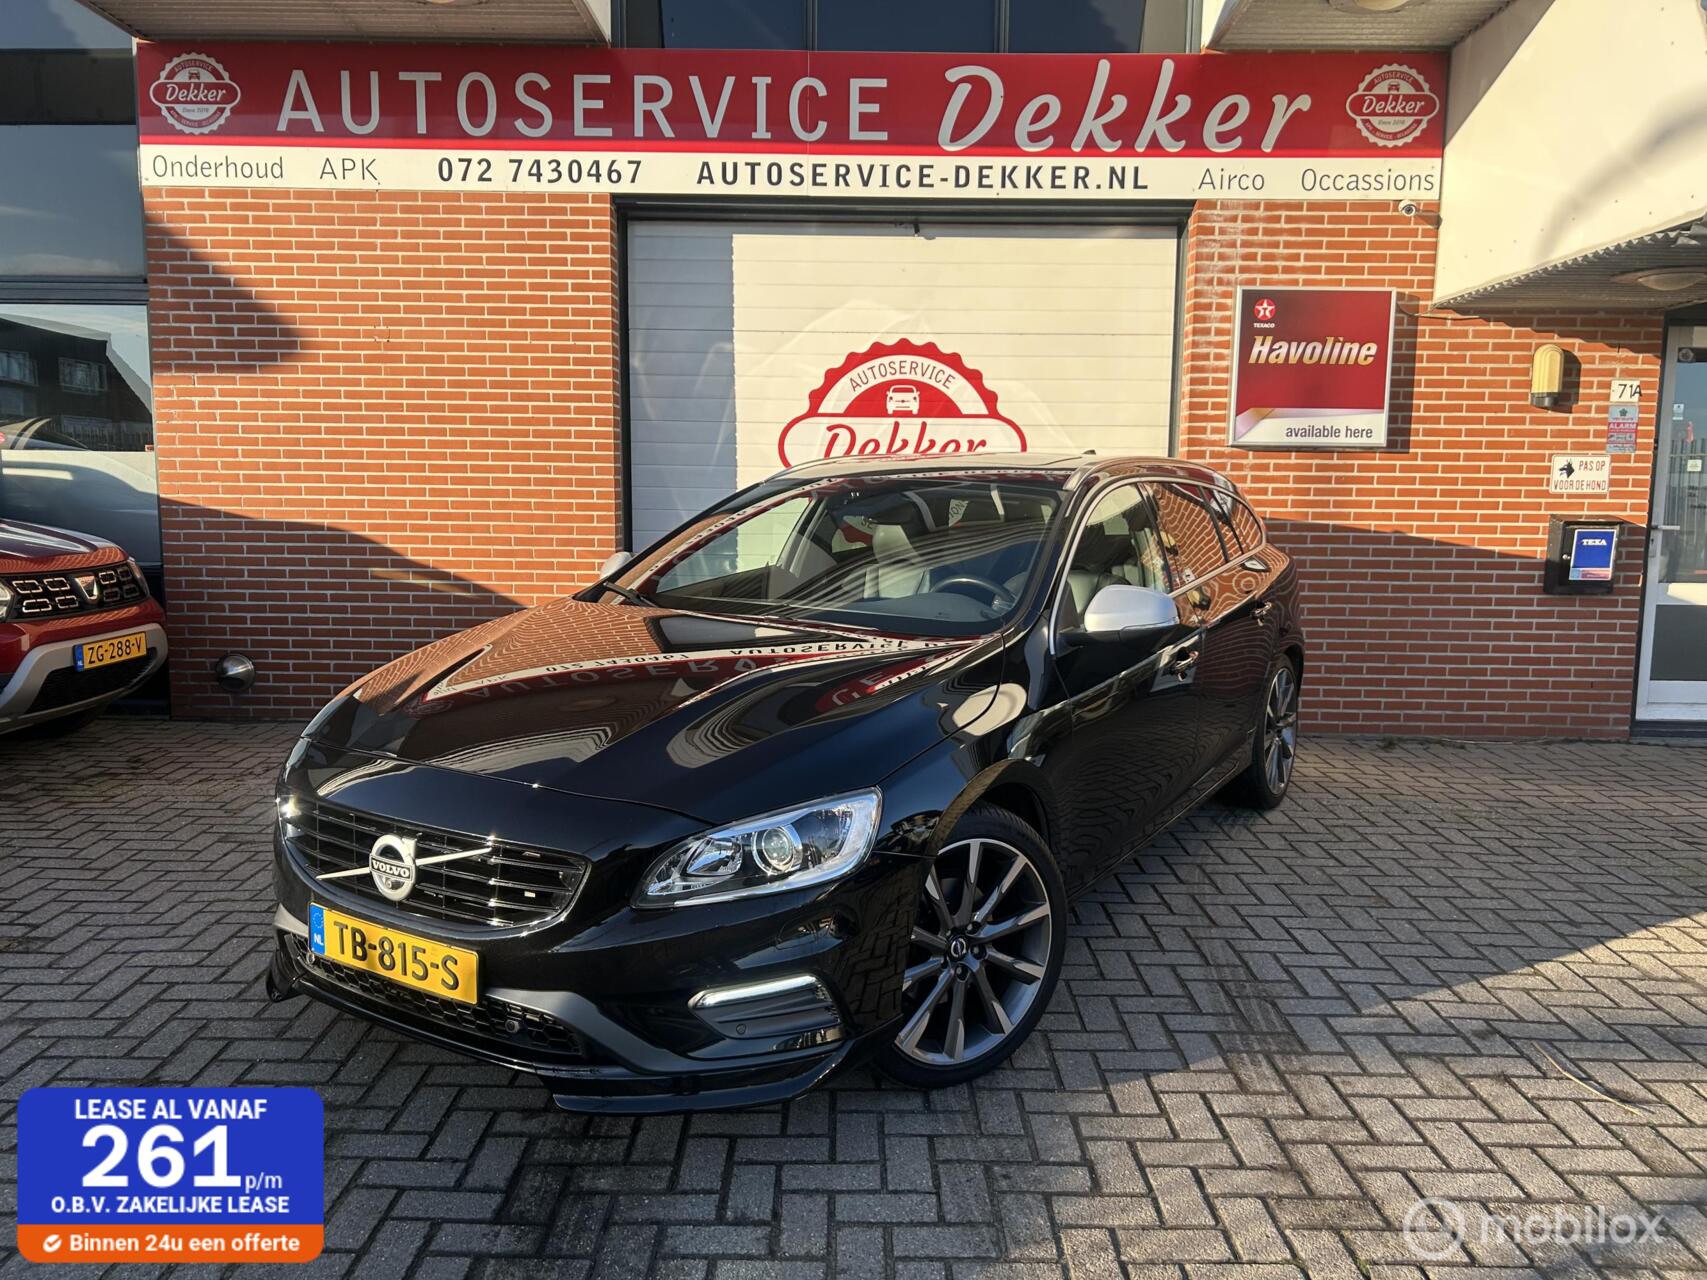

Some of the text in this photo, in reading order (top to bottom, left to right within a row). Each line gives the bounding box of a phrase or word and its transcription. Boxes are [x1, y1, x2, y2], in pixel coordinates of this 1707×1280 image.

[166, 83, 226, 101] Dekker
[276, 58, 1311, 152] AUTOSERVICE Dekker
[1362, 95, 1424, 114] Dekker
[152, 154, 379, 181] Onderhoud APK
[437, 157, 643, 184] 072 7430467
[696, 161, 1149, 190] AUTOSERVICE-DEKKER.NL
[1198, 168, 1435, 191] Airco Occassions
[1248, 335, 1378, 366] Havoline
[849, 360, 956, 392] AUTOSERVICE
[1618, 384, 1643, 398] 71A
[1285, 425, 1373, 438] available here
[1608, 422, 1637, 430] ALARM
[1579, 460, 1606, 471] PAS OP
[1553, 480, 1607, 490] VOOR DE HOND
[88, 637, 142, 664] ZG-288-V
[372, 859, 410, 878] VOLVO
[314, 932, 324, 945] NL
[334, 922, 459, 990] TB-815-S
